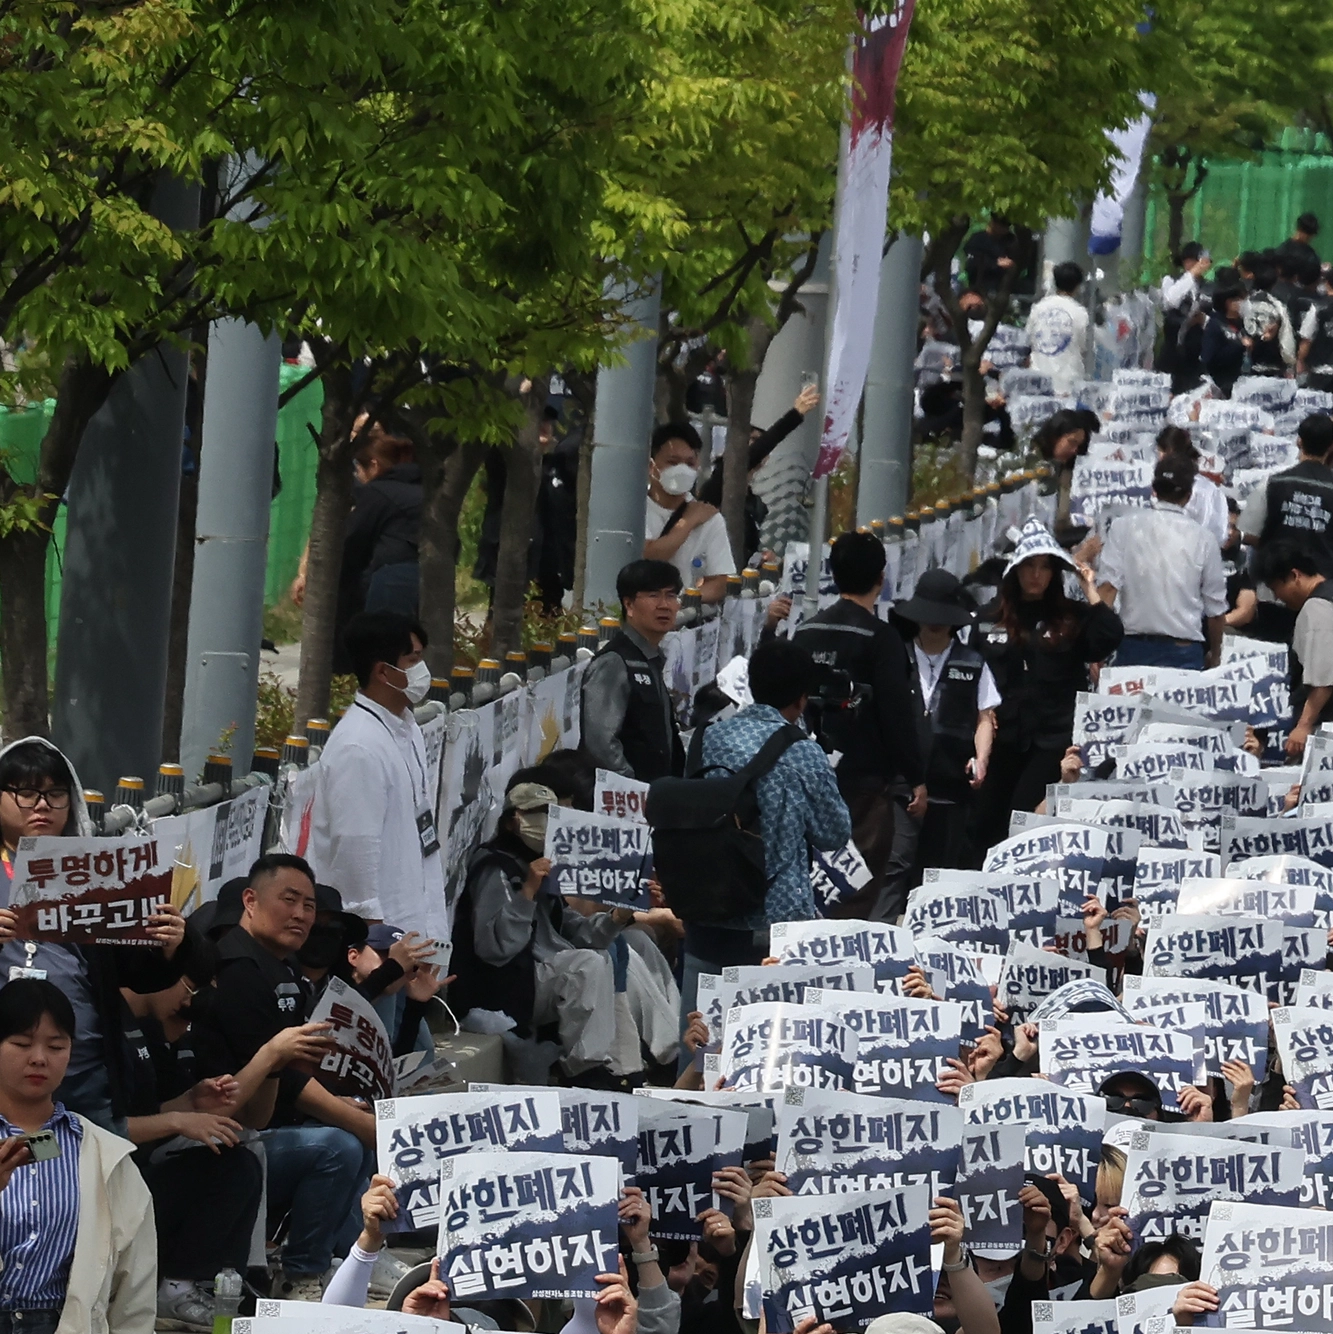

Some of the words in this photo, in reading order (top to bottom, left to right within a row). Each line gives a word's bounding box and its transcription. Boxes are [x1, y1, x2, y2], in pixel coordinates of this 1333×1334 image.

[1175, 783, 1257, 812] 상한폐지
[26, 839, 160, 888] 투명하게
[552, 825, 642, 858] 상한폐지
[1151, 923, 1264, 967] 상한폐지
[730, 1018, 846, 1058] 상한폐지
[387, 1097, 543, 1168] 상한폐지
[791, 1107, 940, 1155] 상한폐지
[444, 1162, 595, 1233] 상한폐지
[1136, 1151, 1281, 1198] 상한폐지
[766, 1193, 908, 1269] 상한폐지
[447, 1229, 619, 1298] 실현하자
[785, 1257, 929, 1329] 실현하자
